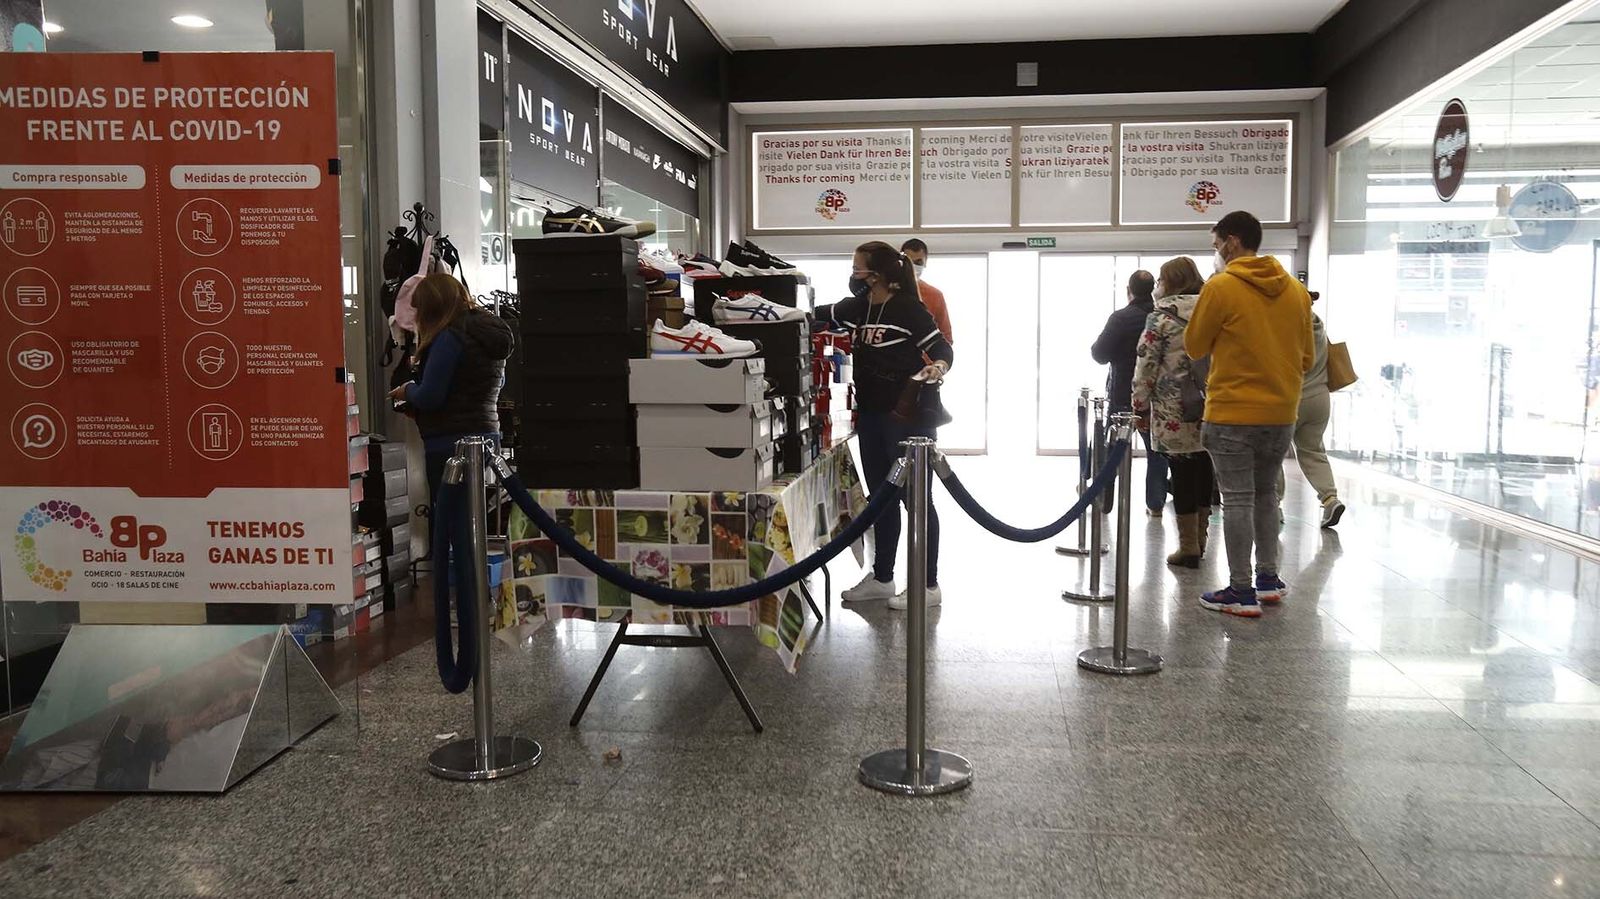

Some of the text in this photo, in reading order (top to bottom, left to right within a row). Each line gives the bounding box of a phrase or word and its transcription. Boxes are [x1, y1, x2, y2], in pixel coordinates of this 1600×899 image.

[603, 9, 669, 78] SPORT WEAR
[0, 81, 309, 108] MEDIDAS DE PROTECCIÓN
[518, 83, 593, 154] NOVA
[28, 120, 281, 140] FRENTE AL COVID-19
[763, 140, 800, 148] Gracias
[802, 140, 819, 149] por
[836, 138, 862, 147] visita
[866, 137, 902, 146] Thanks
[929, 135, 965, 145] coming
[969, 134, 997, 143] Merci
[1000, 134, 1012, 143] de
[1144, 130, 1160, 139] für
[1163, 130, 1191, 139] Ihren
[1194, 129, 1238, 138] Bessuch
[1242, 129, 1289, 139] Obrigado
[530, 133, 586, 167] SPORT WEAR
[786, 151, 817, 160] Vielen
[820, 150, 845, 159] Dank
[848, 149, 862, 158] für
[866, 149, 892, 158] Ihren
[942, 147, 988, 158] Obrigado
[992, 148, 1008, 157] por
[1035, 145, 1062, 154] visita
[1066, 144, 1100, 153] Grazie
[1128, 144, 1138, 152] la
[1140, 143, 1173, 151] vostra
[1176, 142, 1204, 151] visita
[1209, 142, 1254, 151] Shukran
[796, 152, 1286, 173] por sua visita Grazie la vostra visita Sukran liziyaratek por su visita Thanks for
[12, 172, 128, 186] Compra responsable
[184, 172, 307, 186] Medidas de protección
[765, 174, 800, 184] Thanks
[803, 174, 817, 183] for
[820, 174, 855, 184] coming
[860, 172, 887, 182] Merci
[890, 173, 901, 182] de
[940, 171, 966, 180] visite
[972, 171, 1002, 179] Vielen
[1036, 169, 1051, 178] für
[1054, 169, 1081, 178] Ihren
[1130, 167, 1178, 178] Obrigado
[1180, 168, 1198, 178] por
[1221, 166, 1248, 175] visita
[1254, 165, 1287, 175] Grazie
[1029, 239, 1054, 247] SALIDA
[207, 521, 305, 539] TENEMOS
[208, 548, 333, 565] GANAS DE TI
[84, 569, 185, 578] COMERCIO RESTAURACIÓN
[92, 581, 179, 589] OCIO 18 SALAS DE CINE
[210, 582, 335, 592] www.ccbahiaplaza.com
